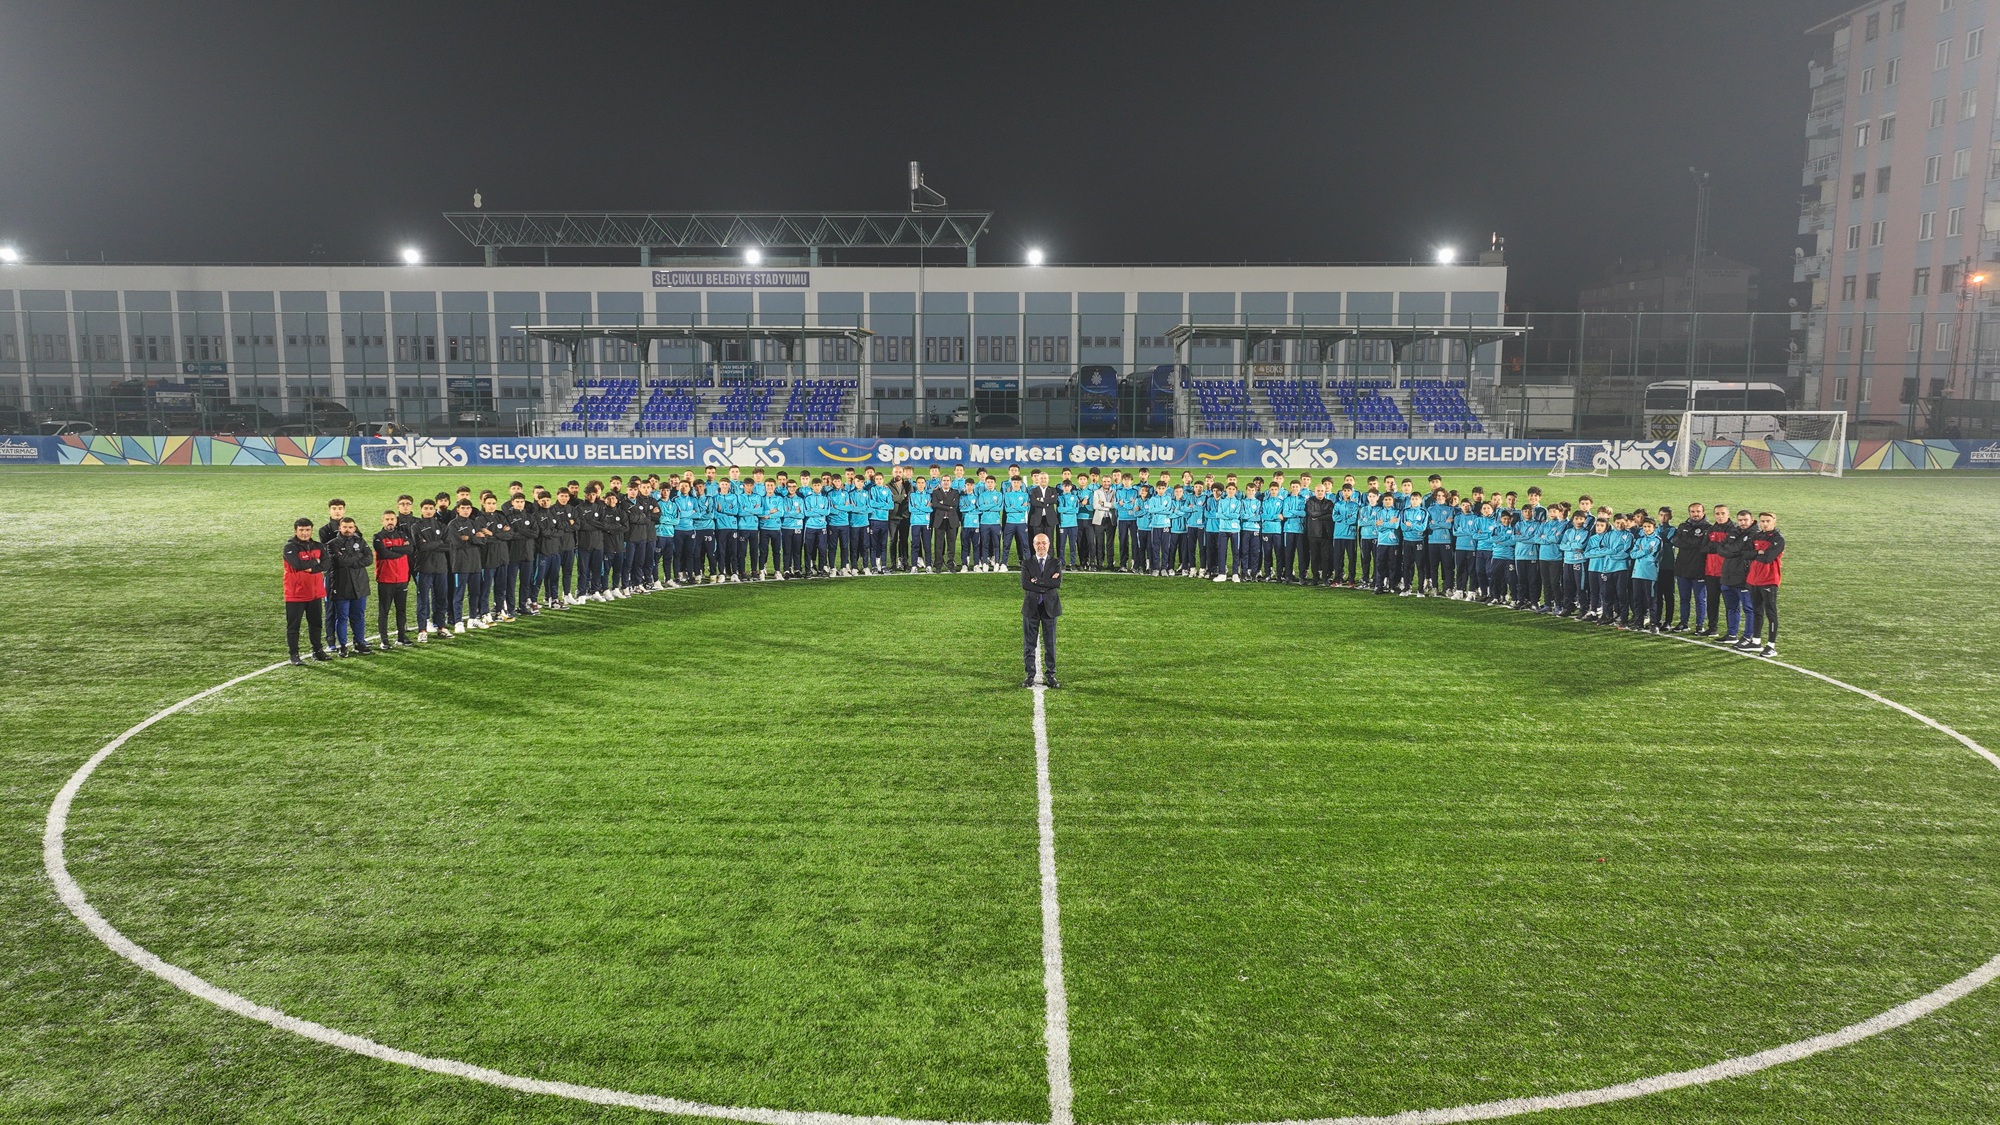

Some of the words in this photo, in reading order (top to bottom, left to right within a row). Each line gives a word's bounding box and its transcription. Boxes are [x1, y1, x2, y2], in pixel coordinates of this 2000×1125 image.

[654, 273, 702, 286] SELÇUKLU
[754, 273, 807, 285] STADYUMU
[479, 443, 579, 463] SELÇUKLU
[584, 440, 695, 460] BELEDİYESİ
[877, 443, 963, 465] Sporun
[969, 443, 1063, 464] Merkezi
[1070, 443, 1175, 464] Selçuklu
[1355, 445, 1459, 465] SELÇUKLU
